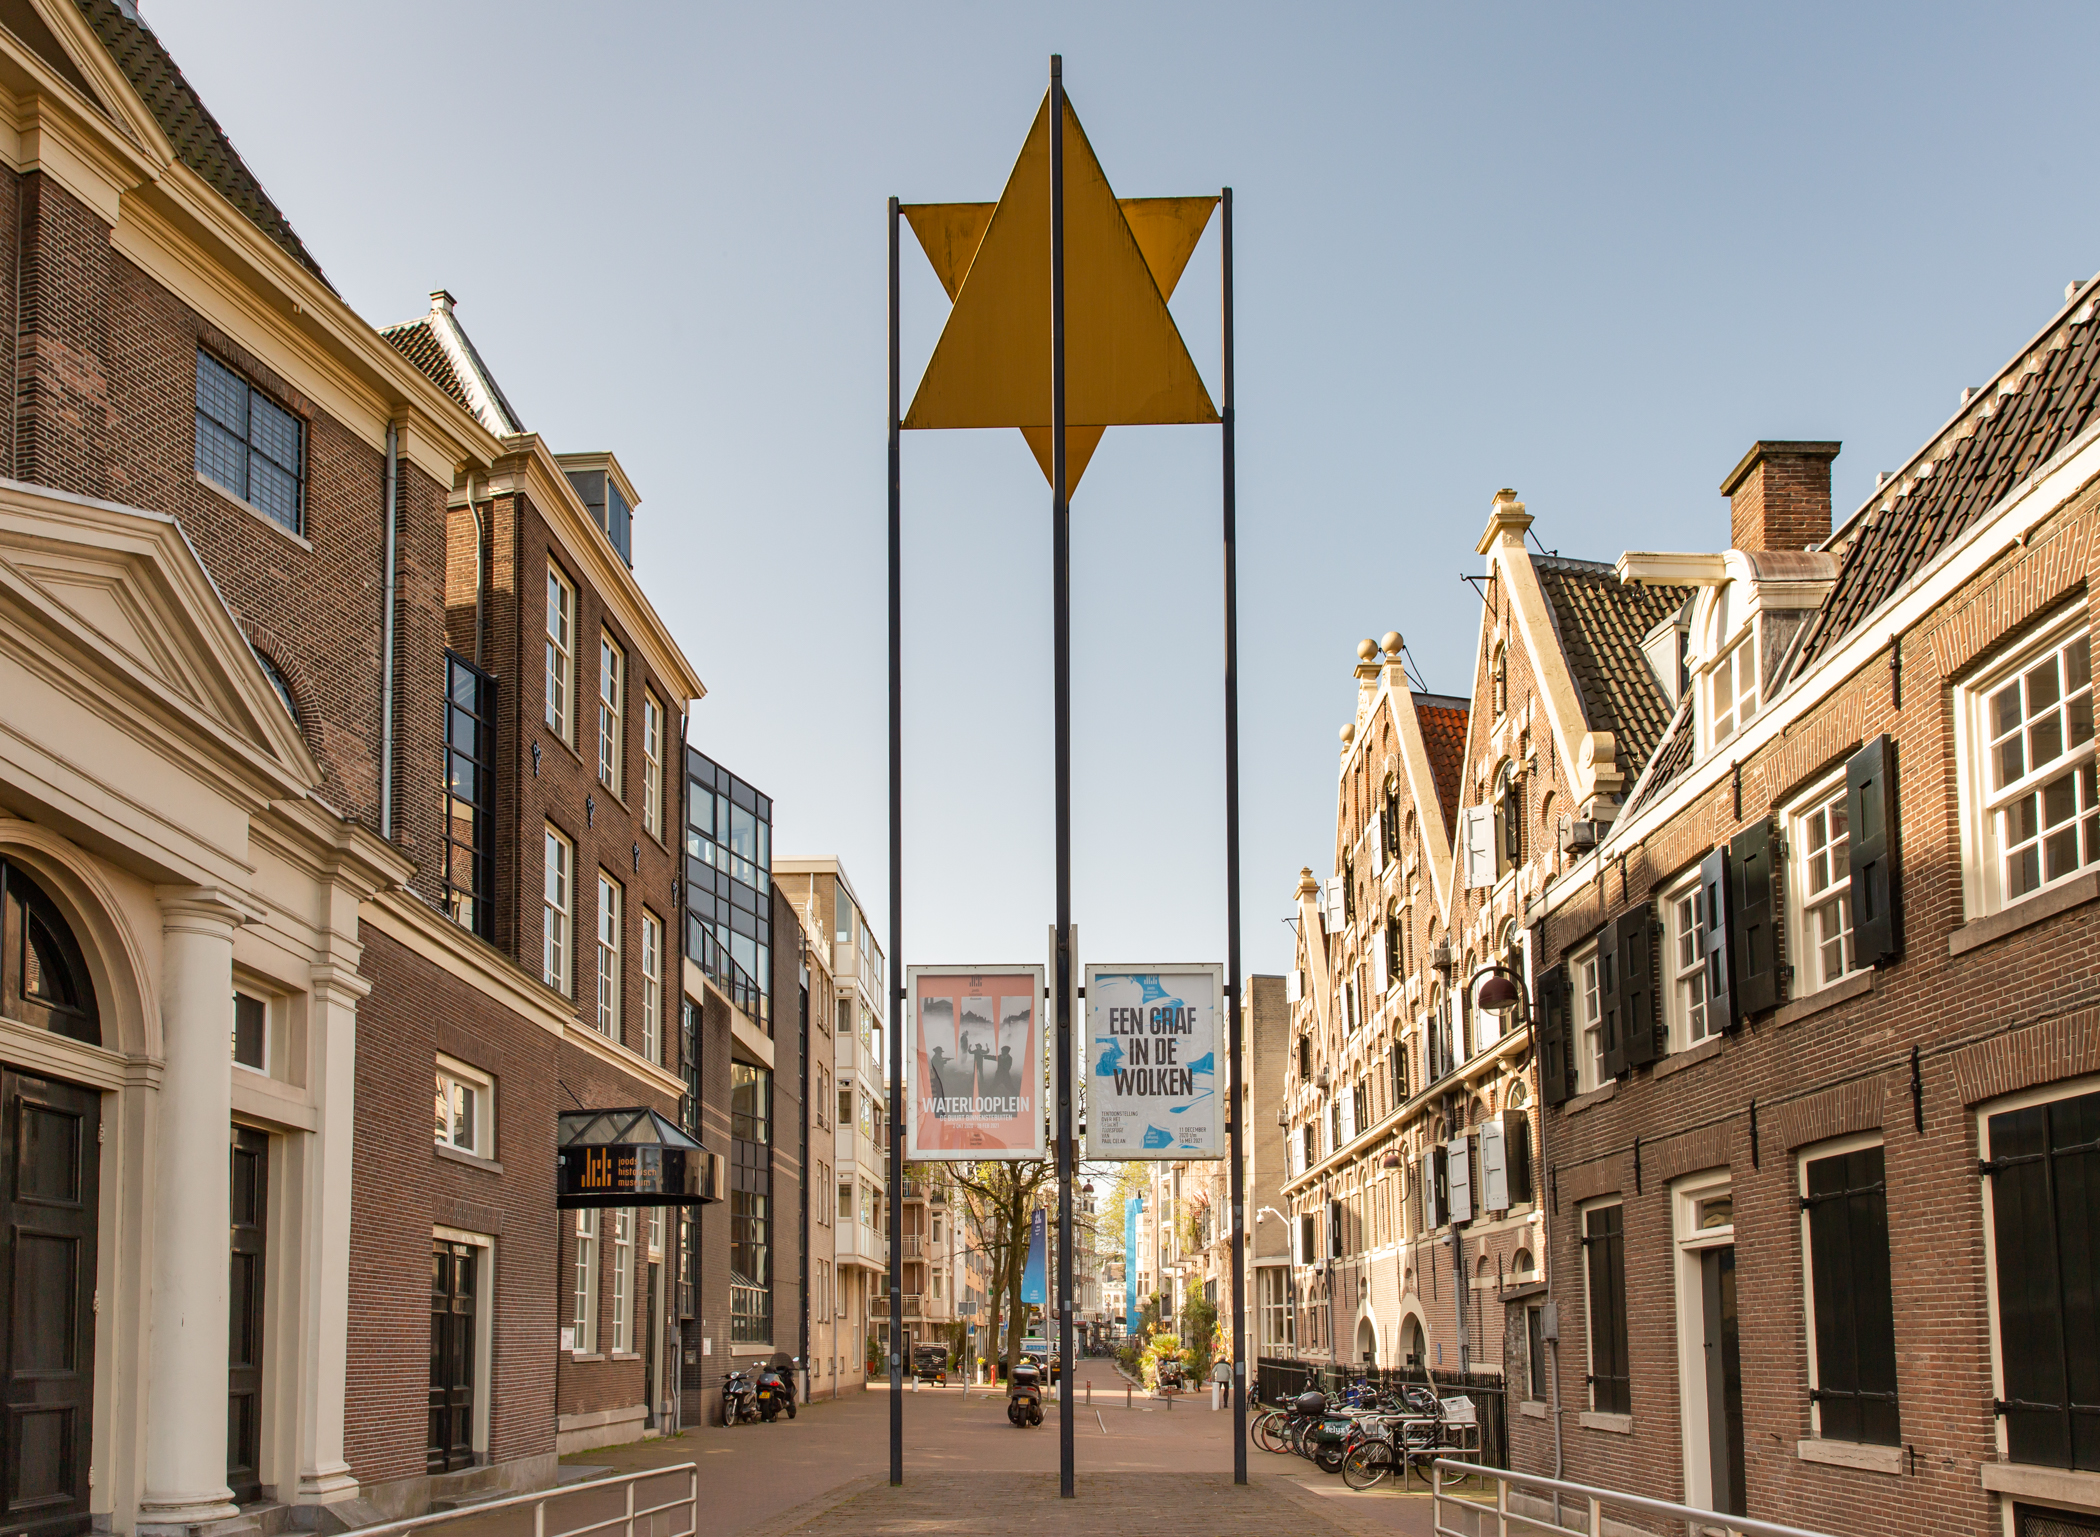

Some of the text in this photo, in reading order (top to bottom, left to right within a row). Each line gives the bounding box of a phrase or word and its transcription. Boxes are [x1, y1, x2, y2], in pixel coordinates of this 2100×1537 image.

[1109, 1007, 1197, 1035] EEN GRAF
[1129, 1038, 1177, 1066] IN DE
[1113, 1068, 1193, 1096] WOLKEN
[922, 1096, 1030, 1113] WATERLOOPLEIN
[940, 1114, 1013, 1122] DE BUURT BINNENSTEBUITEN
[617, 1157, 639, 1166] joods
[617, 1168, 657, 1176] historisch
[617, 1179, 651, 1187] museum
[1325, 1425, 1346, 1435] felyx
